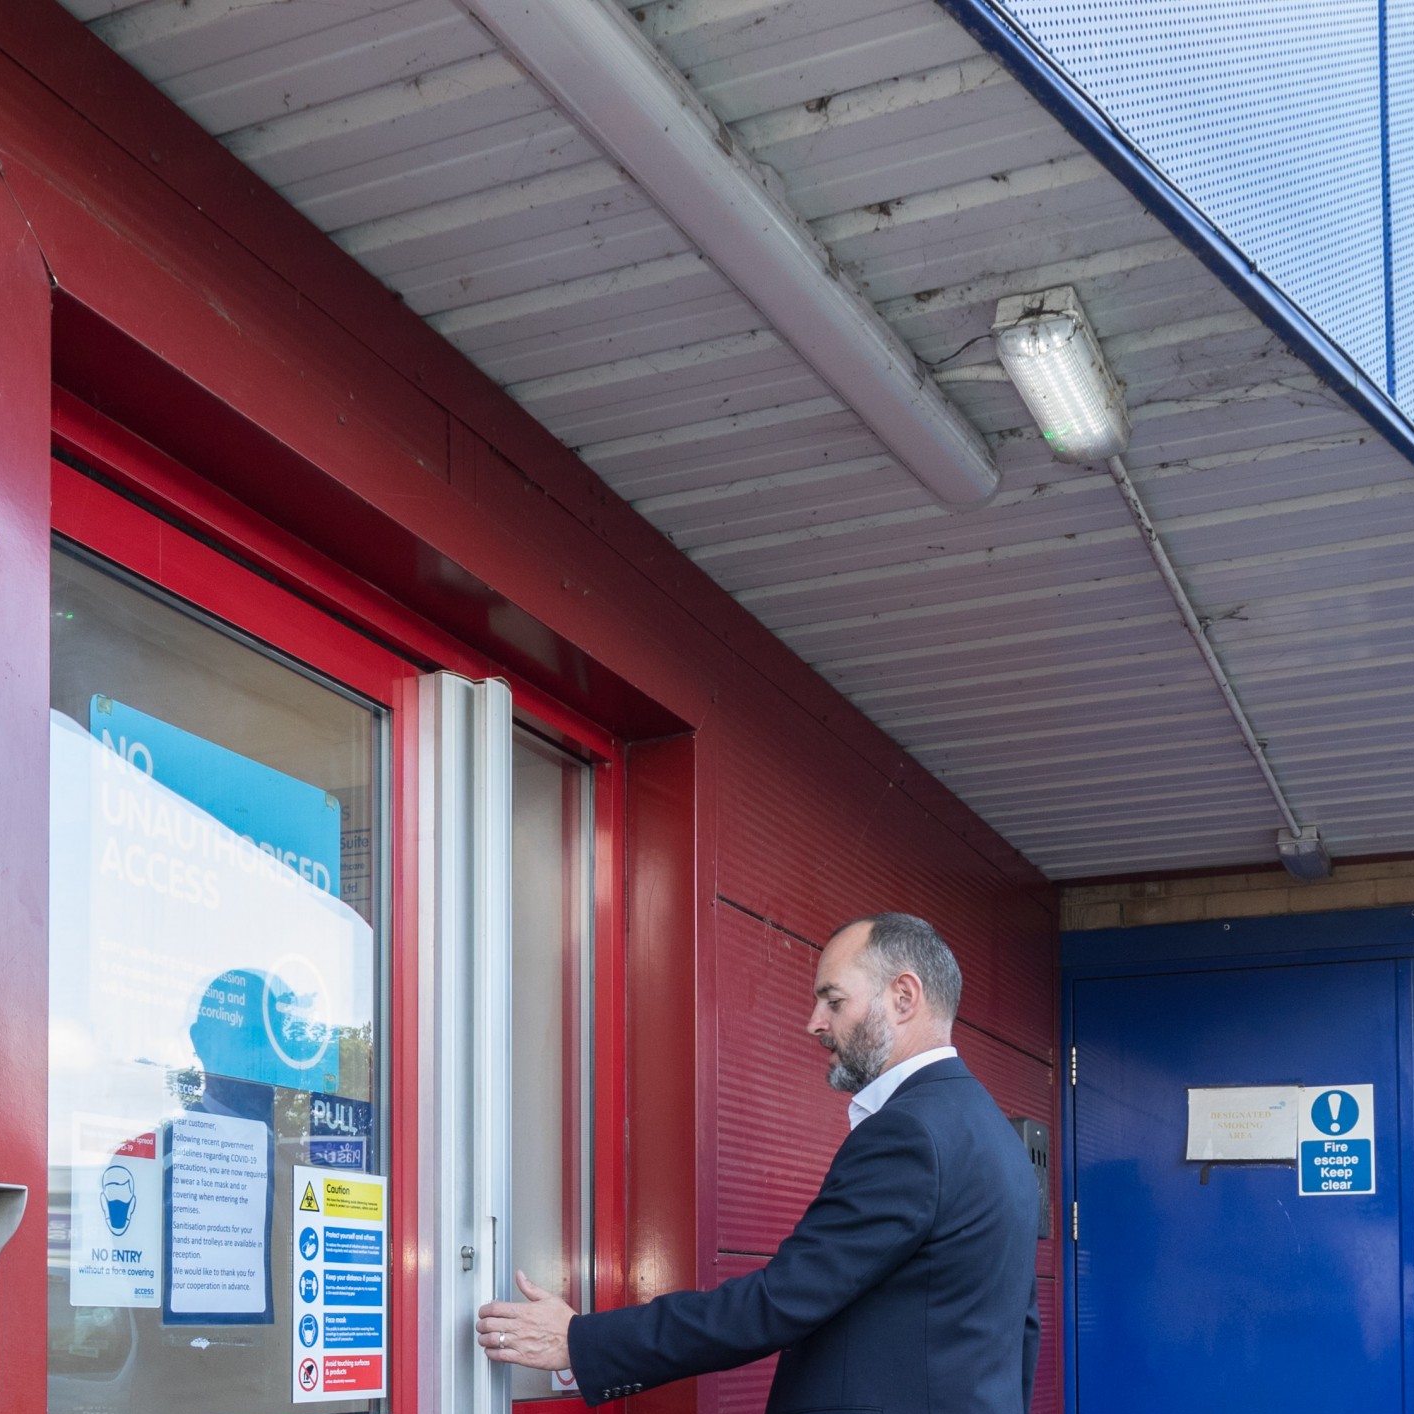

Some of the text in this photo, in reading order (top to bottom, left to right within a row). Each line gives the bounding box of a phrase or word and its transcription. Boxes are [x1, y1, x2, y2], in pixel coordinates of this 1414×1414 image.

[102, 729, 153, 785] NO
[102, 782, 332, 895] UNAUTHORISED
[340, 834, 370, 851] Suite
[100, 837, 221, 911] ACCESS
[342, 881, 359, 895] Ltd
[227, 990, 246, 1006] and
[314, 1099, 358, 1133] PULL
[1210, 1110, 1272, 1120] DESIGNATED
[173, 1117, 217, 1131] Dear customer,
[1217, 1121, 1264, 1130] SMOKING
[173, 1132, 254, 1151] Following recent government
[1228, 1131, 1254, 1140] AREA
[1324, 1142, 1348, 1153] Fire
[173, 1148, 257, 1165] guidelines regarding COVID-19
[1314, 1155, 1359, 1167] escape
[173, 1162, 267, 1179] precautions, you are now required
[1320, 1167, 1353, 1180] Keep
[173, 1176, 179, 1184] to
[201, 1178, 213, 1187] face
[214, 1180, 228, 1189] mask
[229, 1181, 240, 1190] and
[326, 1183, 351, 1195] Caution
[1321, 1179, 1353, 1190] clear
[173, 1191, 249, 1205] covering when entering the
[173, 1205, 201, 1215] premises.
[172, 1221, 253, 1236] Sanitisation products for your
[173, 1236, 190, 1245] hands
[191, 1237, 202, 1245] and
[203, 1238, 223, 1247] trolleys
[233, 1240, 256, 1248] available
[325, 1231, 340, 1239] Protect
[340, 1232, 356, 1240] yourself
[363, 1234, 376, 1242] others
[91, 1247, 143, 1264] NO ENTRY
[172, 1250, 202, 1260] reception.
[79, 1264, 104, 1275] without
[112, 1265, 126, 1276] face
[127, 1266, 155, 1280] covering
[173, 1267, 183, 1275] We
[184, 1267, 202, 1275] would
[202, 1268, 212, 1276] like
[220, 1268, 236, 1277] thank
[236, 1271, 247, 1279] you
[247, 1269, 255, 1277] for
[325, 1273, 336, 1282] Keep
[365, 1275, 381, 1283] possible
[134, 1287, 155, 1296] access
[172, 1283, 186, 1291] your
[186, 1282, 221, 1291] cooperation
[228, 1283, 250, 1291] advance.
[325, 1316, 346, 1324] Face mask
[325, 1359, 370, 1368] Avoid touching surfaces
[329, 1368, 347, 1377] products
